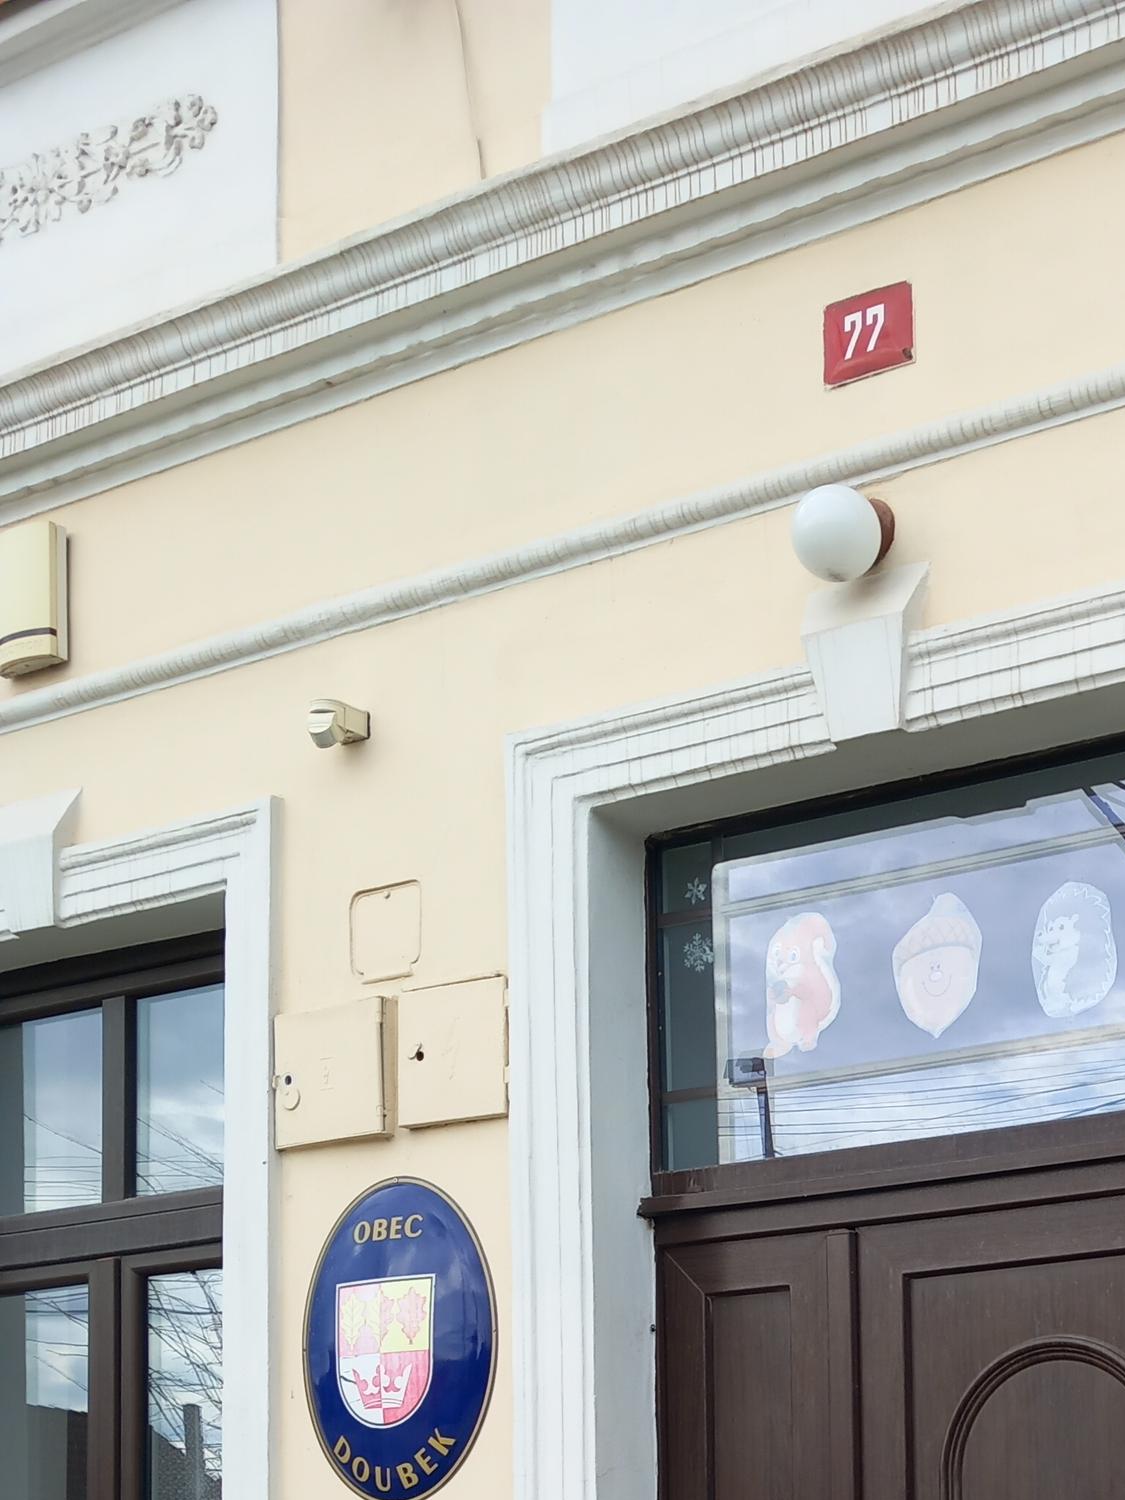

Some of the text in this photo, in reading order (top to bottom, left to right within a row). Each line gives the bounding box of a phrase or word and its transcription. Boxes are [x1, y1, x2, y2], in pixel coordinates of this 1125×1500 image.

[843, 302, 885, 361] 77
[353, 1213, 424, 1245] OBEC
[333, 1427, 457, 1493] DOUBEK
